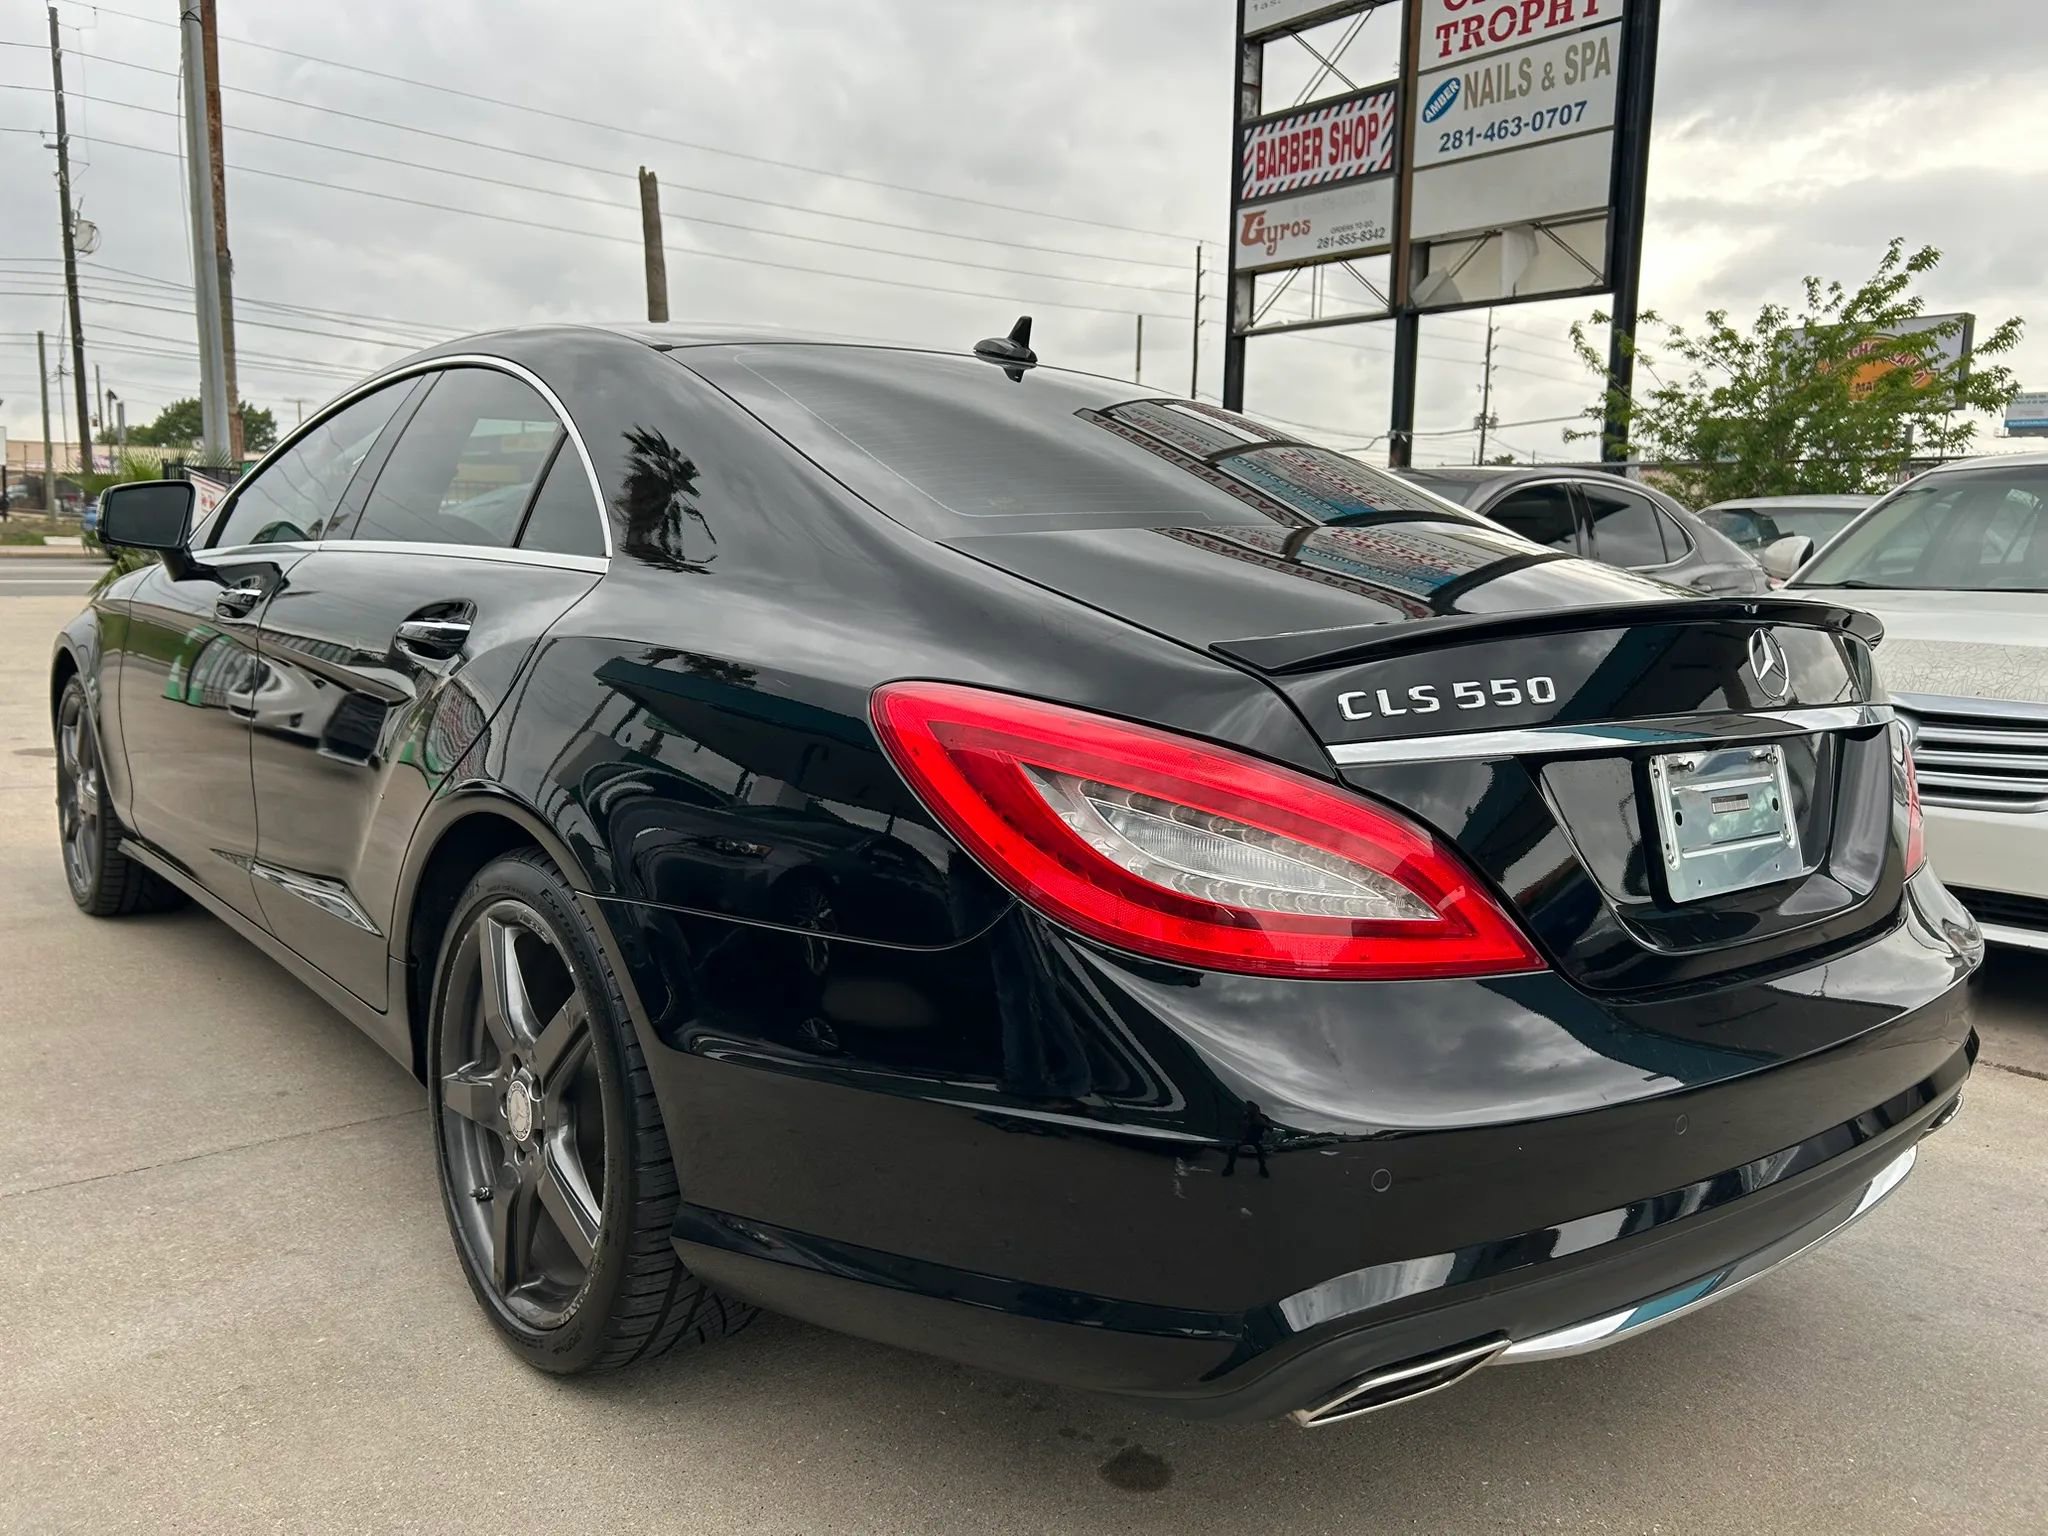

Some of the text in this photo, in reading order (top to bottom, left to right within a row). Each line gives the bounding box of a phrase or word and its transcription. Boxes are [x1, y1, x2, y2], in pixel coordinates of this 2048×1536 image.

[1464, 36, 1611, 110] NAILS & SPA
[1256, 112, 1379, 182] BARBER SHOP
[1439, 100, 1587, 153] 281-463-0707
[1240, 210, 1311, 256] Gyros
[1338, 676, 1556, 721] CLS 550
